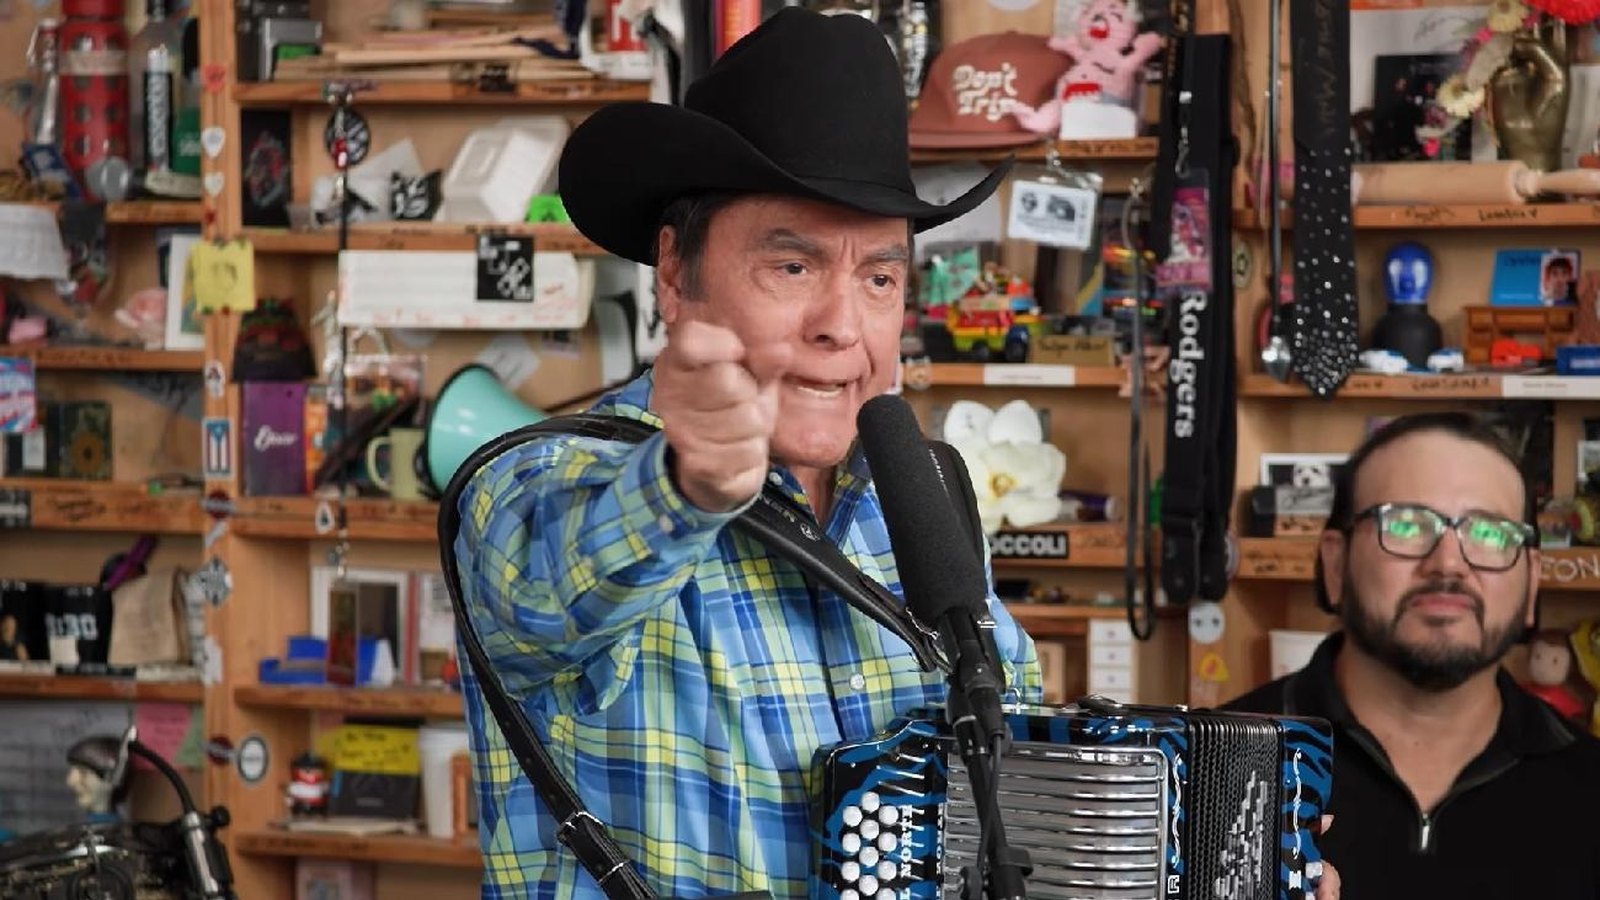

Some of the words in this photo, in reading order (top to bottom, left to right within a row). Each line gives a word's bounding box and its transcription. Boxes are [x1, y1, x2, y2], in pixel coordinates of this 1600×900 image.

[953, 62, 1018, 97] Don't
[1169, 291, 1207, 438] Rodgers
[901, 804, 913, 878] NORTE
